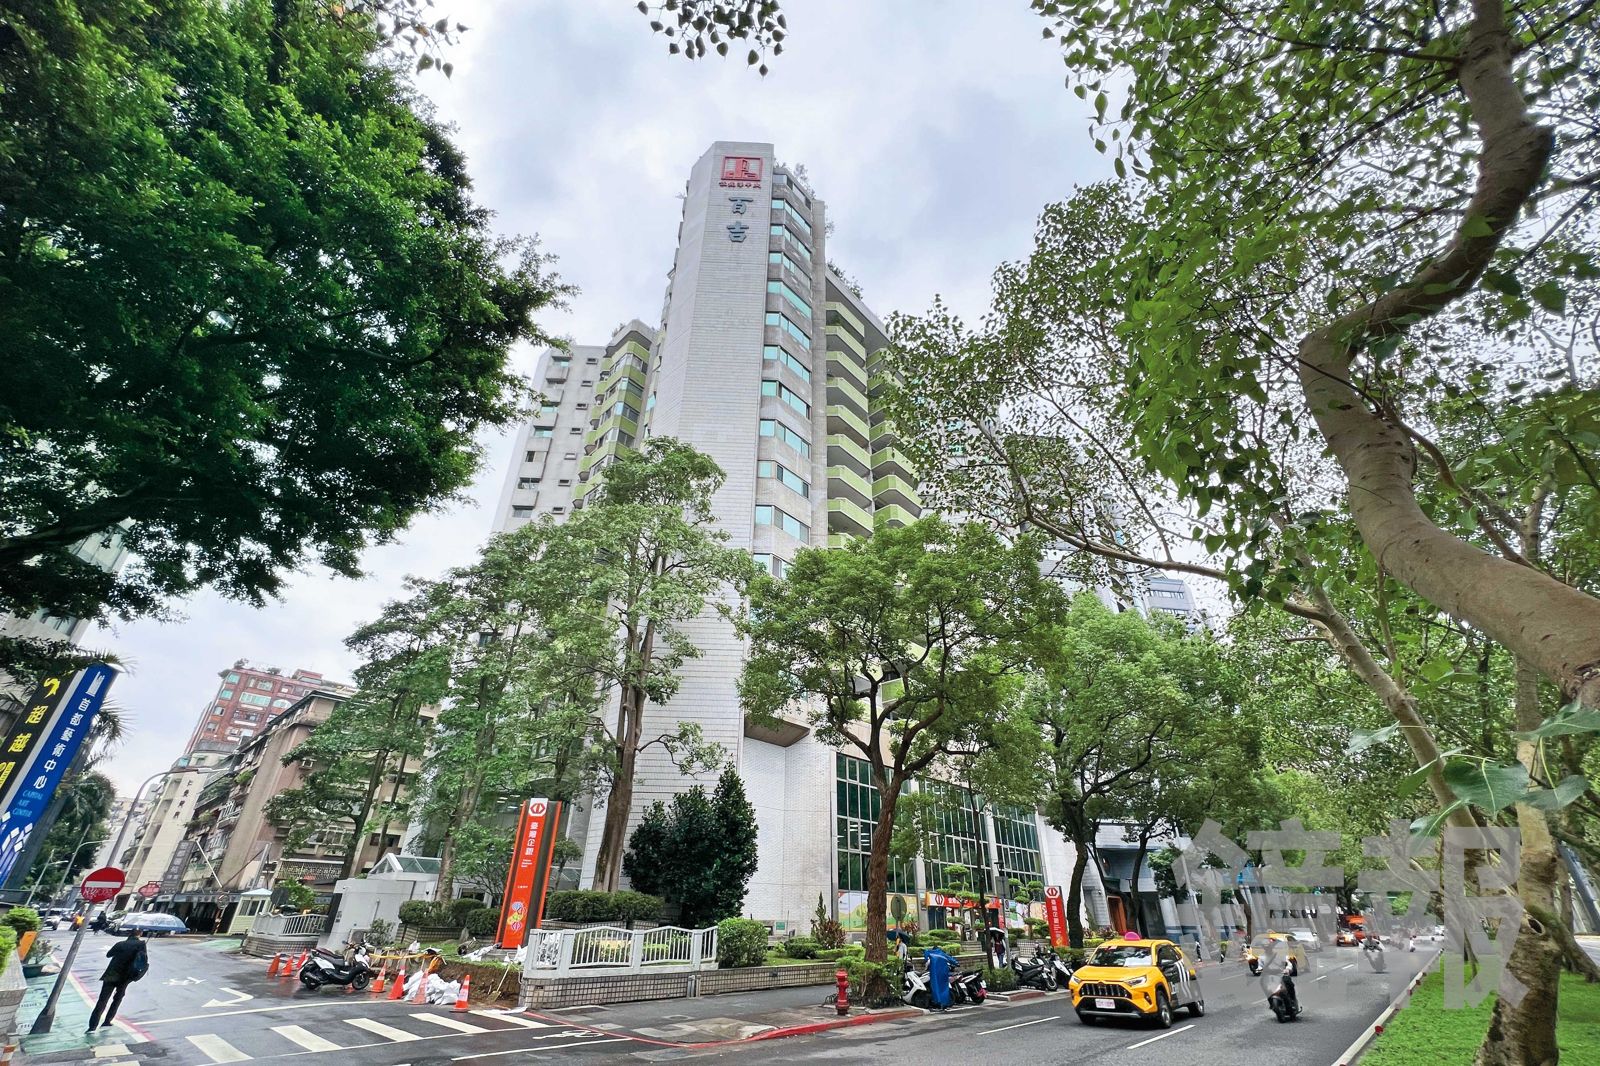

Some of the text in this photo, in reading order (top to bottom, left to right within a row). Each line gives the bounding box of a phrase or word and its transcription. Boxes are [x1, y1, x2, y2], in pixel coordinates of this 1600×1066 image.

[33, 698, 91, 789] 首都藝術中心
